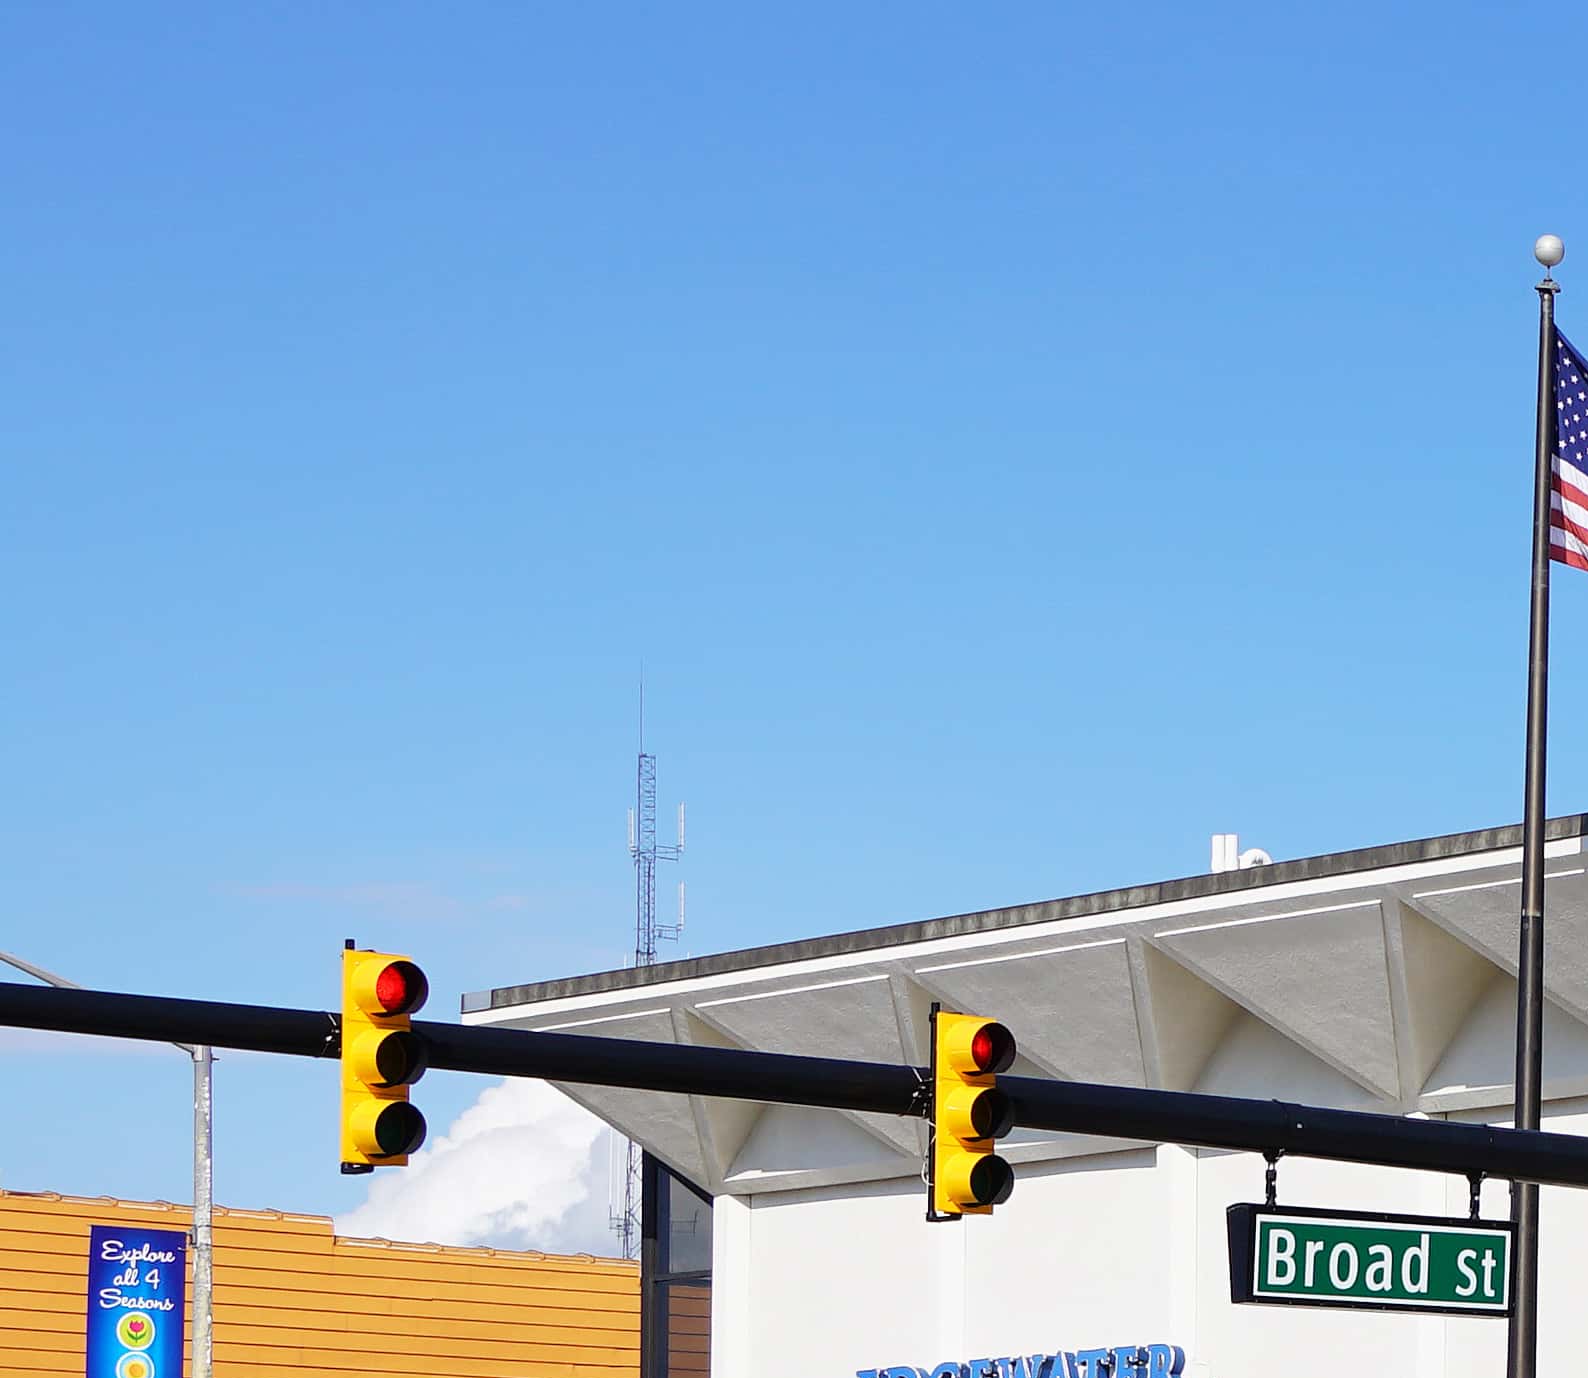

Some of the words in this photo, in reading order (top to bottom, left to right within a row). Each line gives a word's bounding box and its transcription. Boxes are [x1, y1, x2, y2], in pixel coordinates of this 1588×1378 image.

[101, 1240, 175, 1268] Explore
[1267, 1229, 1430, 1293] Broad
[113, 1267, 139, 1286] all
[145, 1268, 160, 1290] 4
[100, 1288, 175, 1311] Seasons
